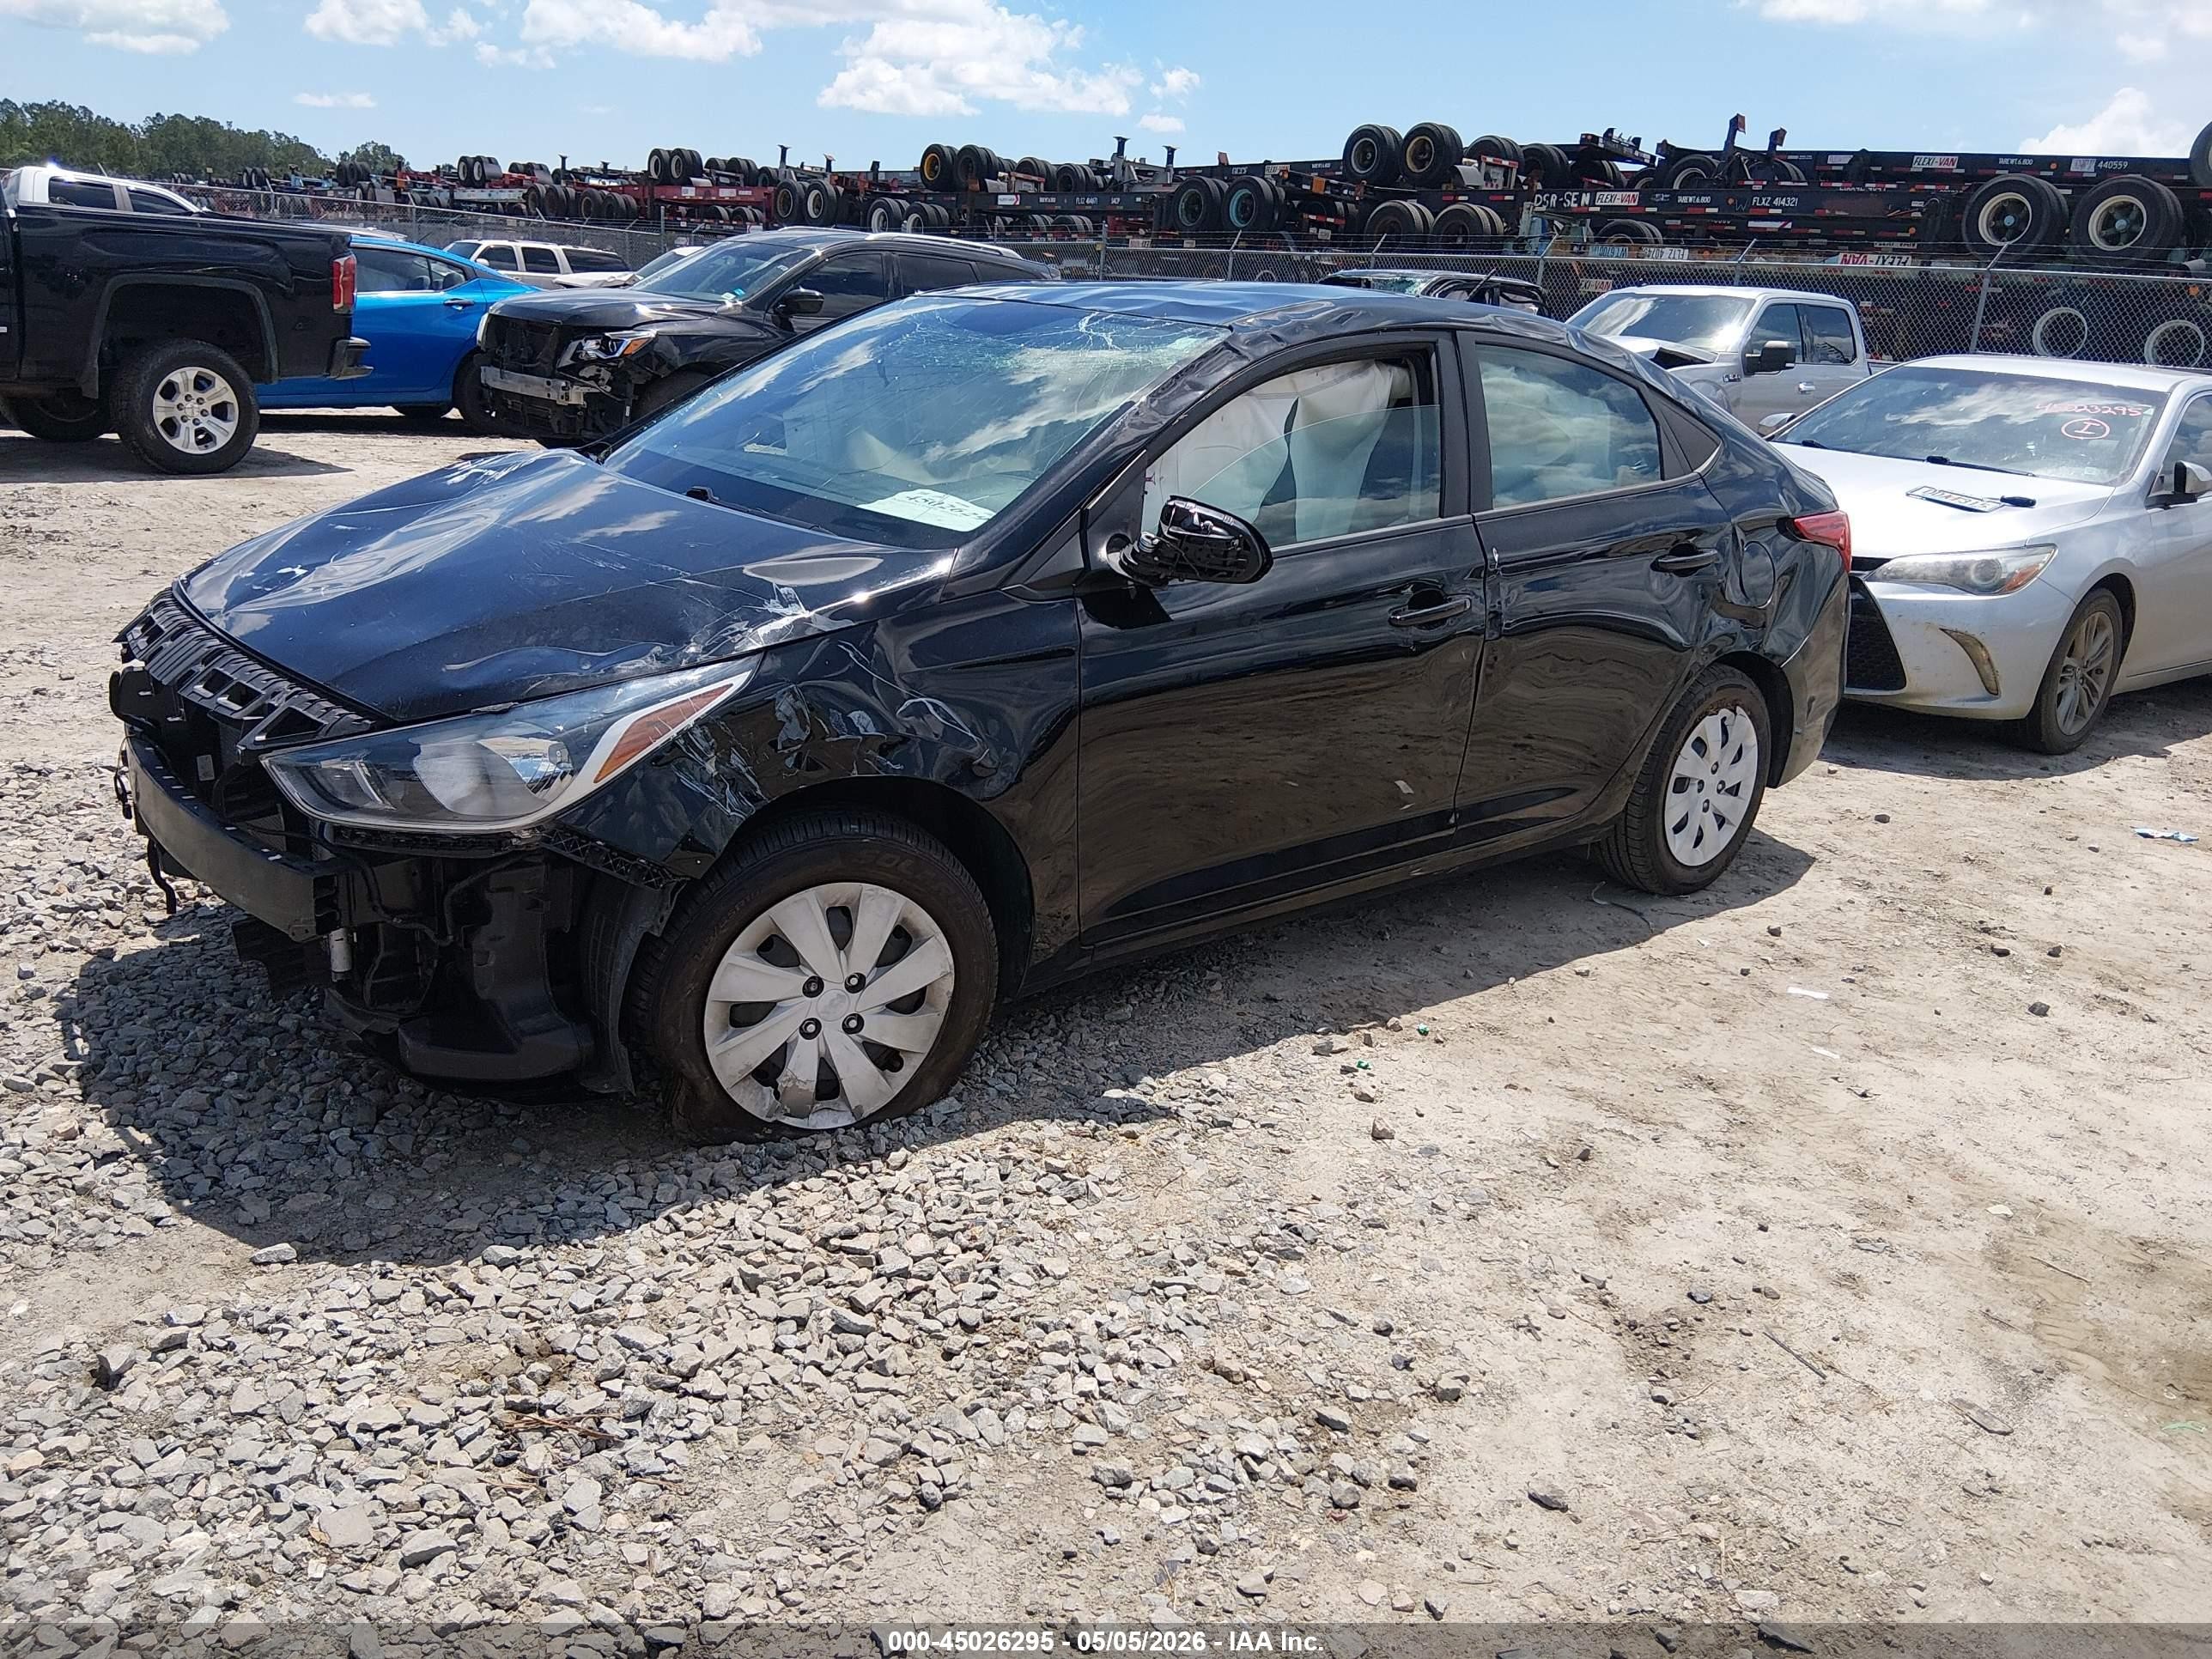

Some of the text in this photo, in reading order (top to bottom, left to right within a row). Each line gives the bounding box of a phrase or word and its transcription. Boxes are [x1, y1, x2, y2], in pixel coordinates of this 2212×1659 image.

[1913, 156, 1958, 167] FLEXI-VAN
[2098, 161, 2129, 170] 440559
[1596, 192, 1638, 205] FLEXI-VAN
[1752, 197, 1798, 207] FLXZ 414321
